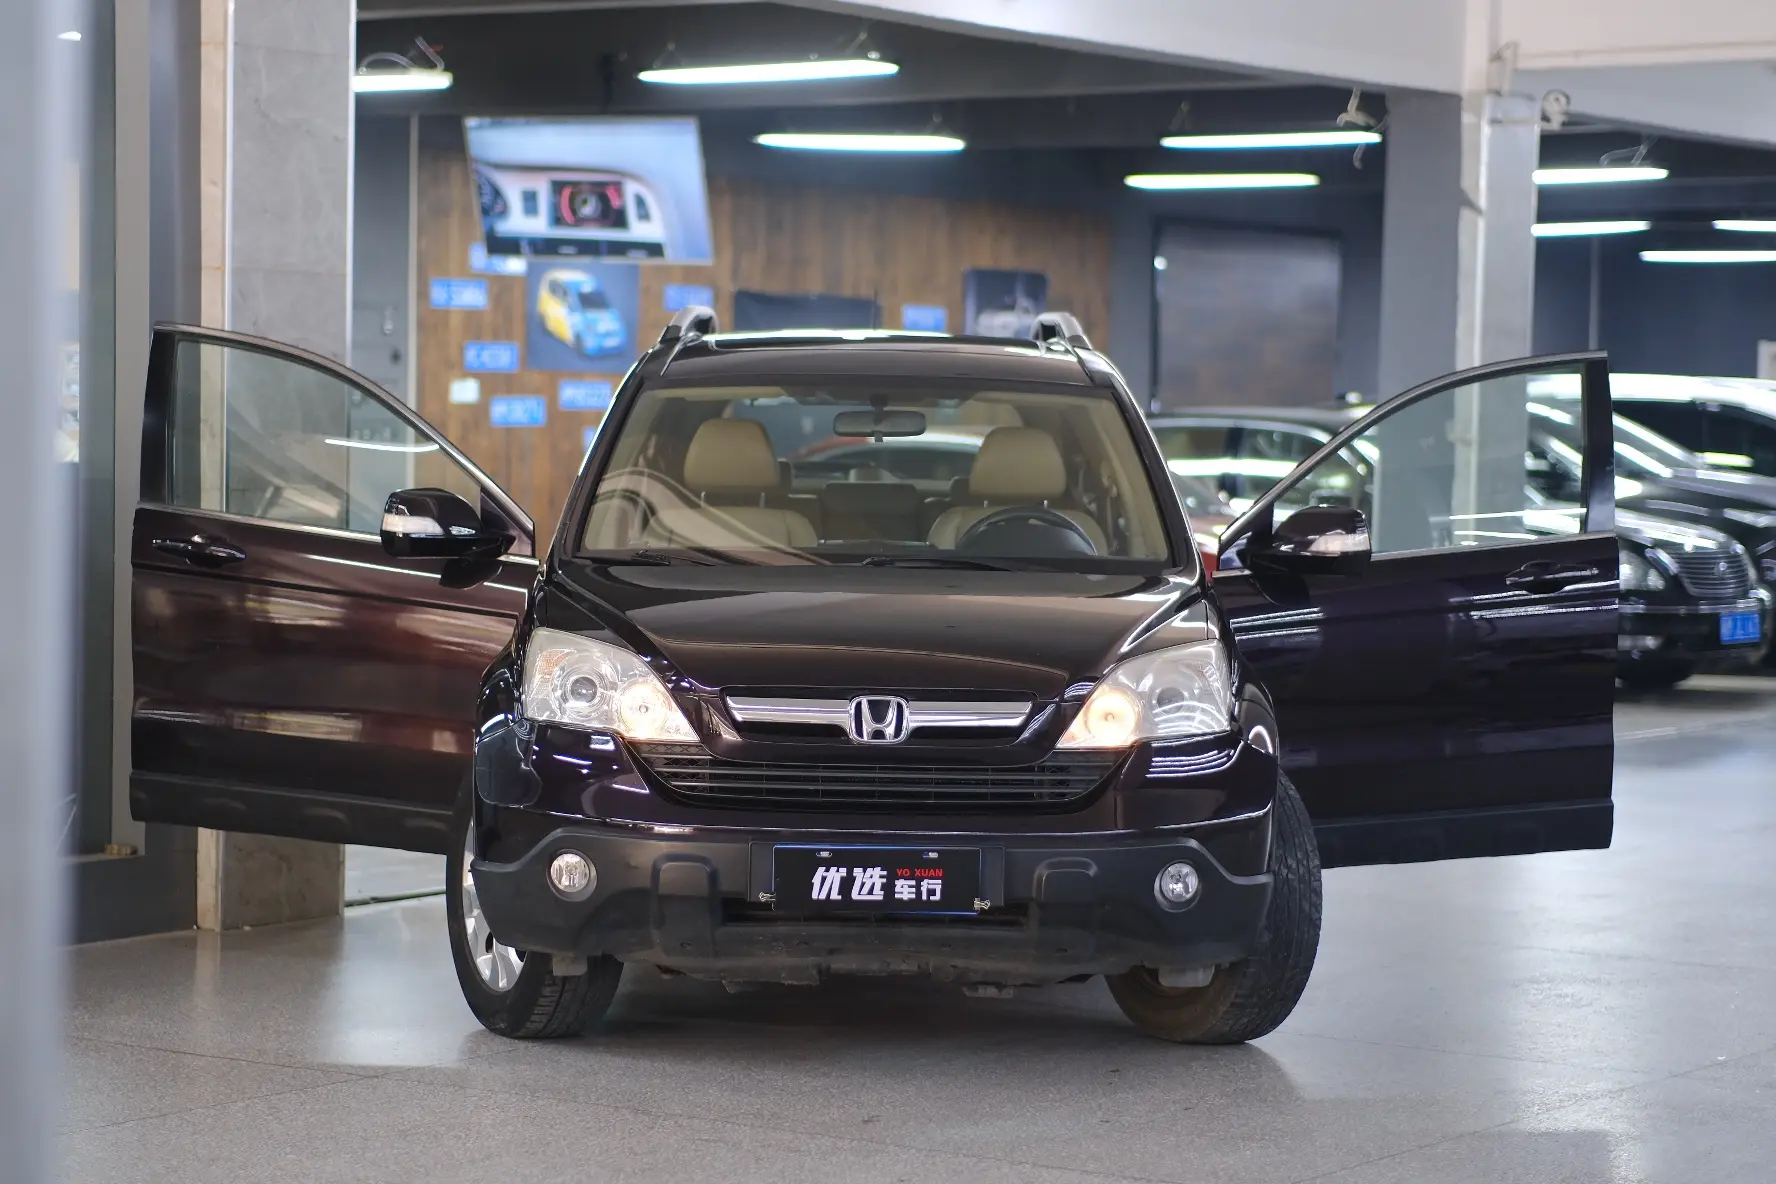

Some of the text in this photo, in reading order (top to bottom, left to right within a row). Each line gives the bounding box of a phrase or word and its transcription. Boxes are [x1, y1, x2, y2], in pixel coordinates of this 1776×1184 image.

[812, 867, 887, 900] 优选
[896, 868, 943, 877] YO XUAN
[895, 879, 942, 901] 车行
